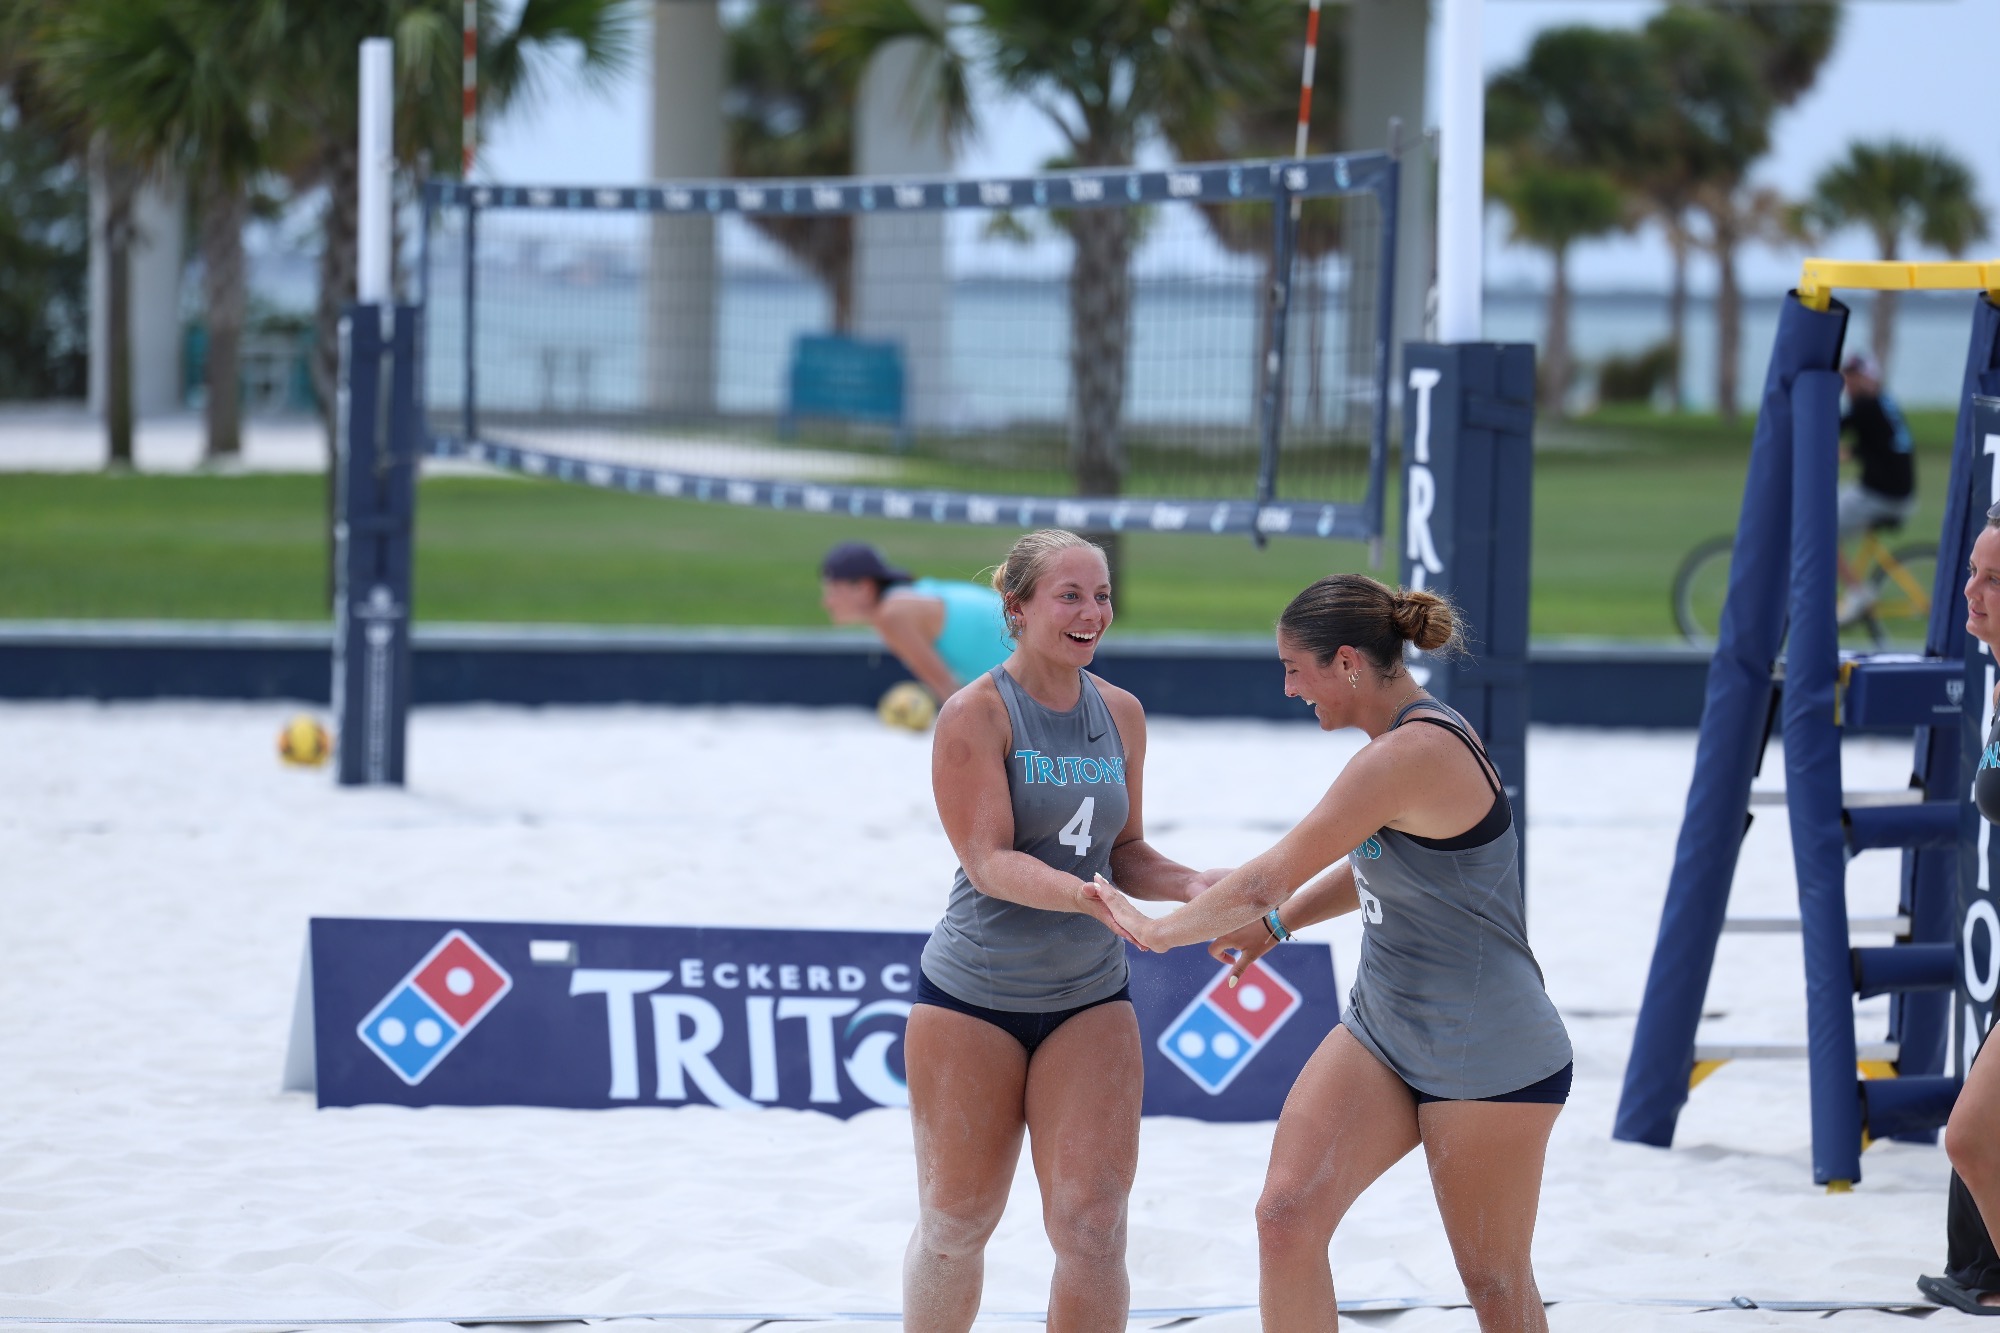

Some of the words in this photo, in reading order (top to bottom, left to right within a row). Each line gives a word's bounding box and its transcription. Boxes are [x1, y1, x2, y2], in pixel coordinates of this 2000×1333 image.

[1014, 749, 1126, 787] TRITONS
[1058, 796, 1095, 857] 4
[680, 957, 867, 992] ECKERD
